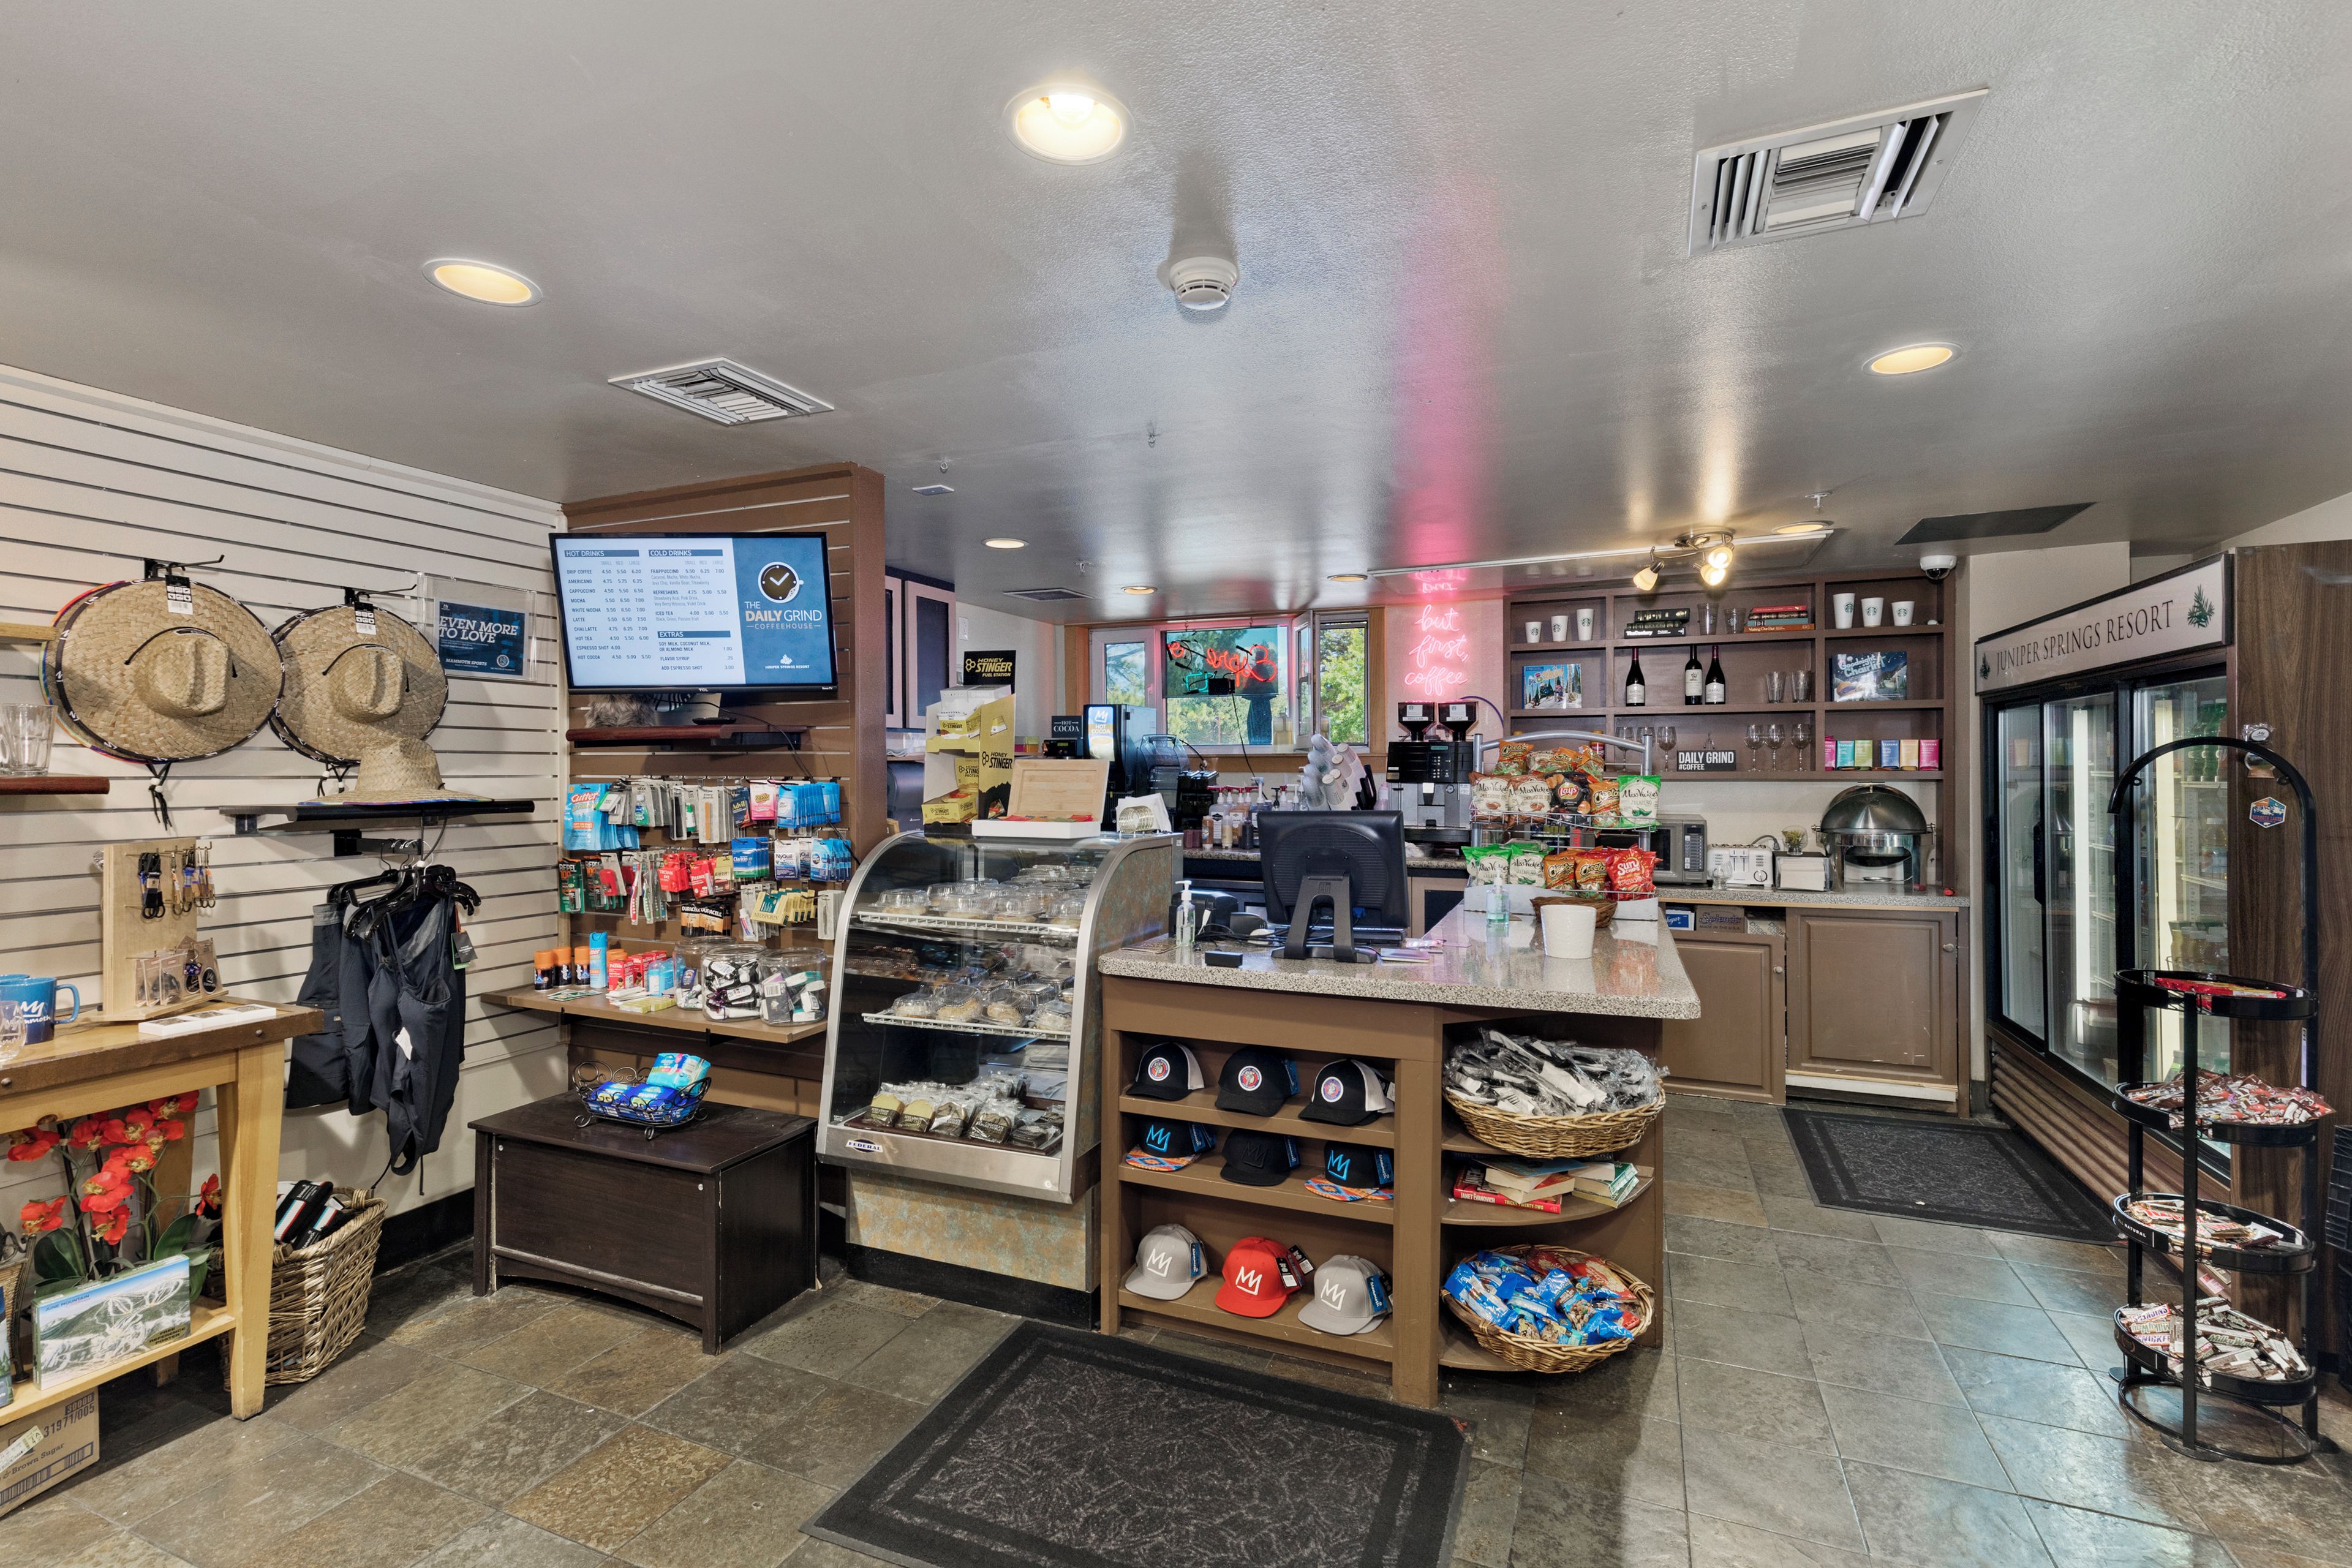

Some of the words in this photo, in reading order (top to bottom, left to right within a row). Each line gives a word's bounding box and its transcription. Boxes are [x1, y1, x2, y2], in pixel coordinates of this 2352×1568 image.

[745, 601, 761, 609] THE
[745, 610, 782, 622] DAILY
[783, 609, 823, 622] GRIND
[1414, 604, 1460, 631] but
[439, 616, 477, 630] EVEN
[478, 620, 518, 636] MORE
[439, 627, 458, 639] TO
[460, 629, 497, 643] LOVE
[1997, 641, 2040, 676] JUNIPER
[2043, 622, 2100, 660] SPRINGS
[2106, 600, 2173, 644] RESORT
[975, 662, 1013, 673] STINGER
[1839, 654, 1877, 670] Goodnight
[1844, 655, 1887, 677] Chairlift
[1404, 666, 1468, 696] coffee
[1501, 744, 1529, 756] Cheetos
[989, 758, 1013, 769] STINGER
[1679, 752, 1705, 764] DAILY
[1706, 752, 1734, 764] GRIND
[1479, 782, 1491, 791] Miss
[1491, 781, 1508, 792] Vickie
[1559, 785, 1578, 796] Lay's
[571, 792, 600, 804] Cutter
[1623, 789, 1638, 798] Miss
[732, 801, 745, 810] Advil
[559, 863, 577, 872] REPEL
[1548, 864, 1574, 879] Cheetos
[560, 870, 571, 879] 100
[701, 907, 722, 917] DURACELL
[754, 912, 779, 921] NEOSPORIN
[1699, 912, 1741, 925] Splenda
[848, 1142, 881, 1151] FEDERAL
[1460, 1192, 1472, 1200] JANET
[1473, 1193, 1495, 1204] EVANOVICH
[2124, 1223, 2146, 1238] NATURAL
[45, 1303, 60, 1311] JUNE
[61, 1294, 90, 1306] MOUNTAIN
[149, 1327, 186, 1343] REFERENCE
[159, 1327, 176, 1335] FREE
[155, 1333, 181, 1344] POSTER
[2209, 1333, 2234, 1346] Milky
[2234, 1336, 2255, 1348] Way
[67, 1395, 92, 1413] 30000
[43, 1403, 94, 1438] 31971/005
[12, 1458, 39, 1474] Brown
[41, 1442, 64, 1459] Sugar
